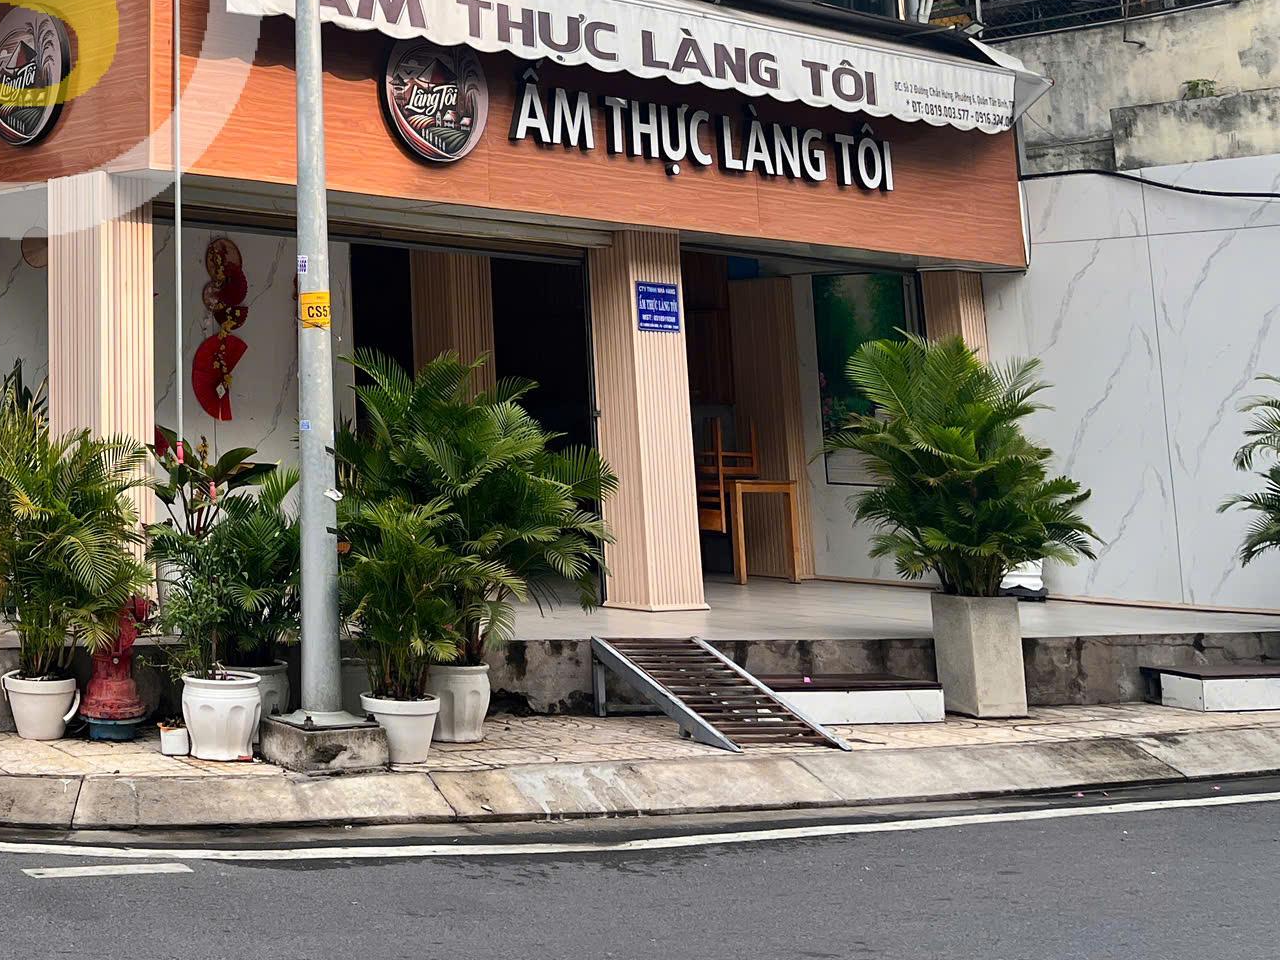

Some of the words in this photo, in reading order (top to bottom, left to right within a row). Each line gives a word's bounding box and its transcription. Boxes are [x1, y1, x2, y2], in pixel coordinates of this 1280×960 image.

[641, 28, 779, 89] LÀNG
[802, 59, 878, 106] TÔI
[605, 95, 713, 175] THỰC
[723, 104, 827, 181] LÀNG
[835, 123, 894, 190] TÔI
[924, 102, 970, 121] 0819.003.577
